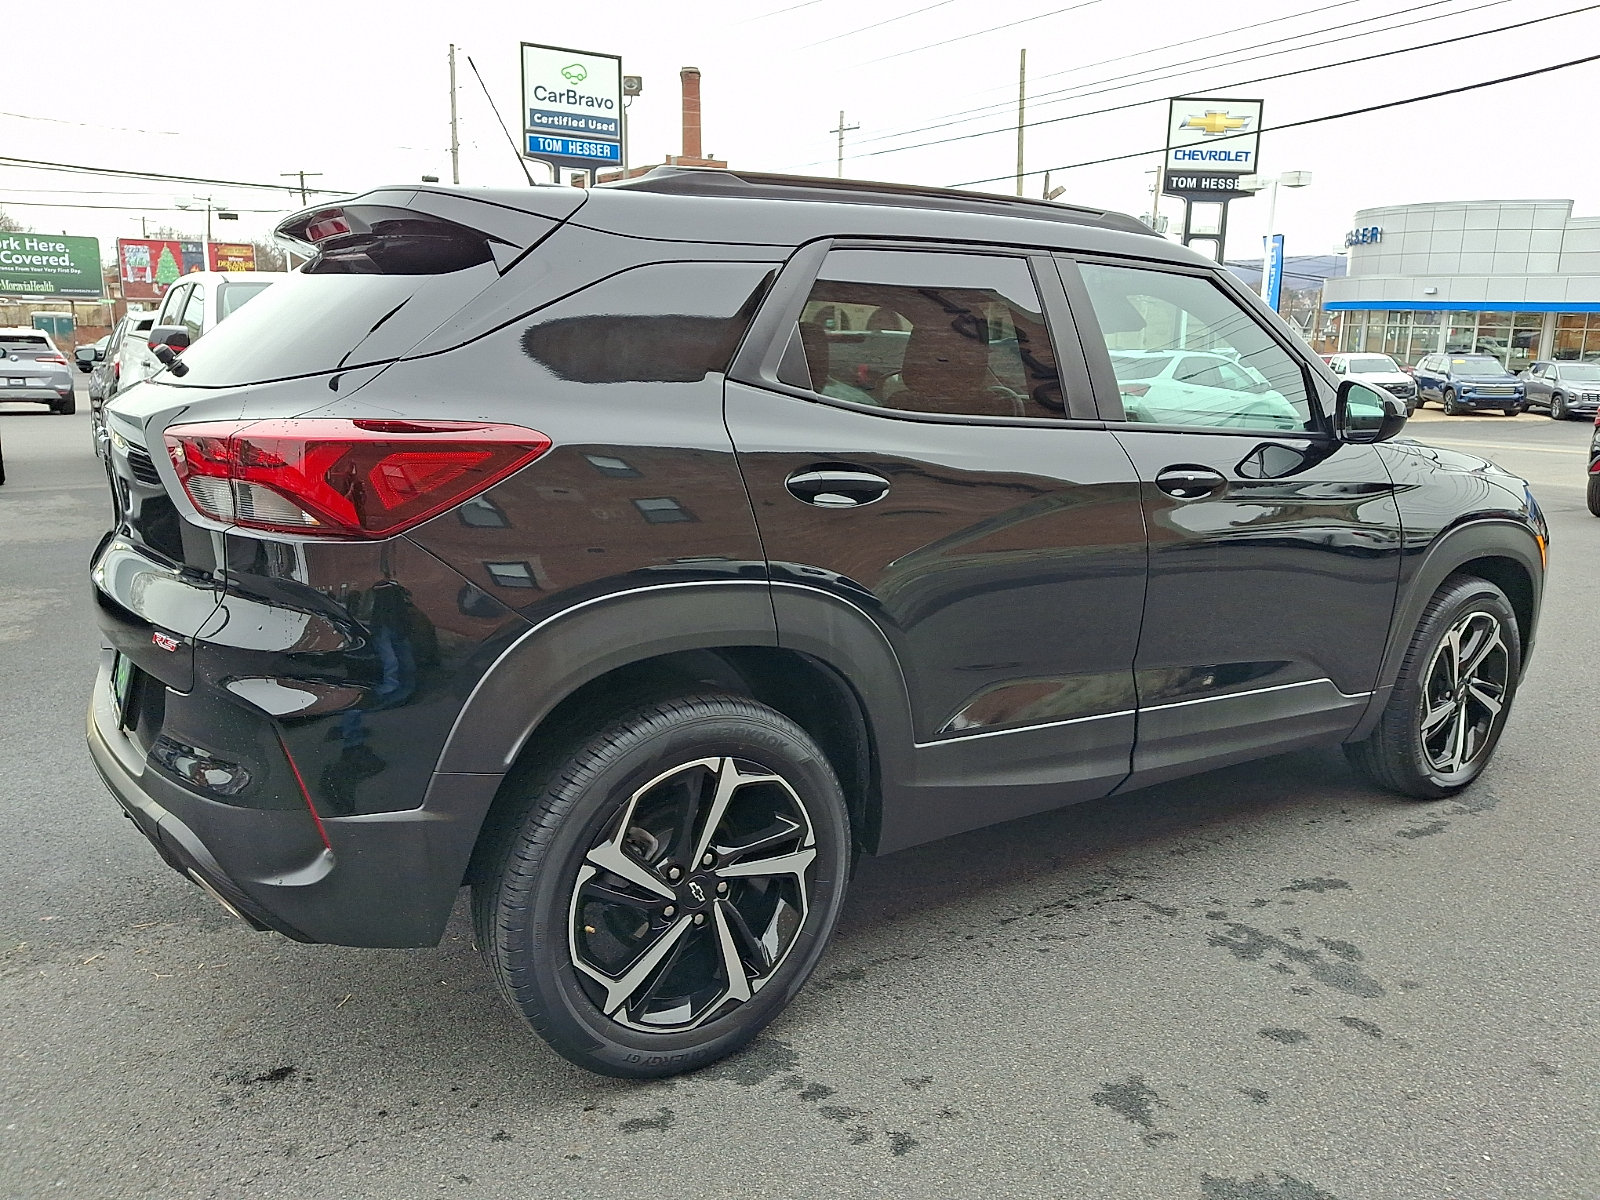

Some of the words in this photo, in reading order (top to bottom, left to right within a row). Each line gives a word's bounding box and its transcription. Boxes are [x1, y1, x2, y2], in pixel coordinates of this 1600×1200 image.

[533, 85, 614, 110] CarBravo
[533, 113, 586, 128] Certified
[588, 119, 615, 132] Used
[537, 138, 562, 153] TOM
[568, 141, 611, 157] HESSER
[1174, 149, 1251, 162] CHEVROLET
[1171, 177, 1197, 189] TOM
[1201, 178, 1240, 190] HESSE
[24, 237, 70, 253] Here.
[0, 250, 75, 267] Covered.
[152, 631, 181, 652] RS
